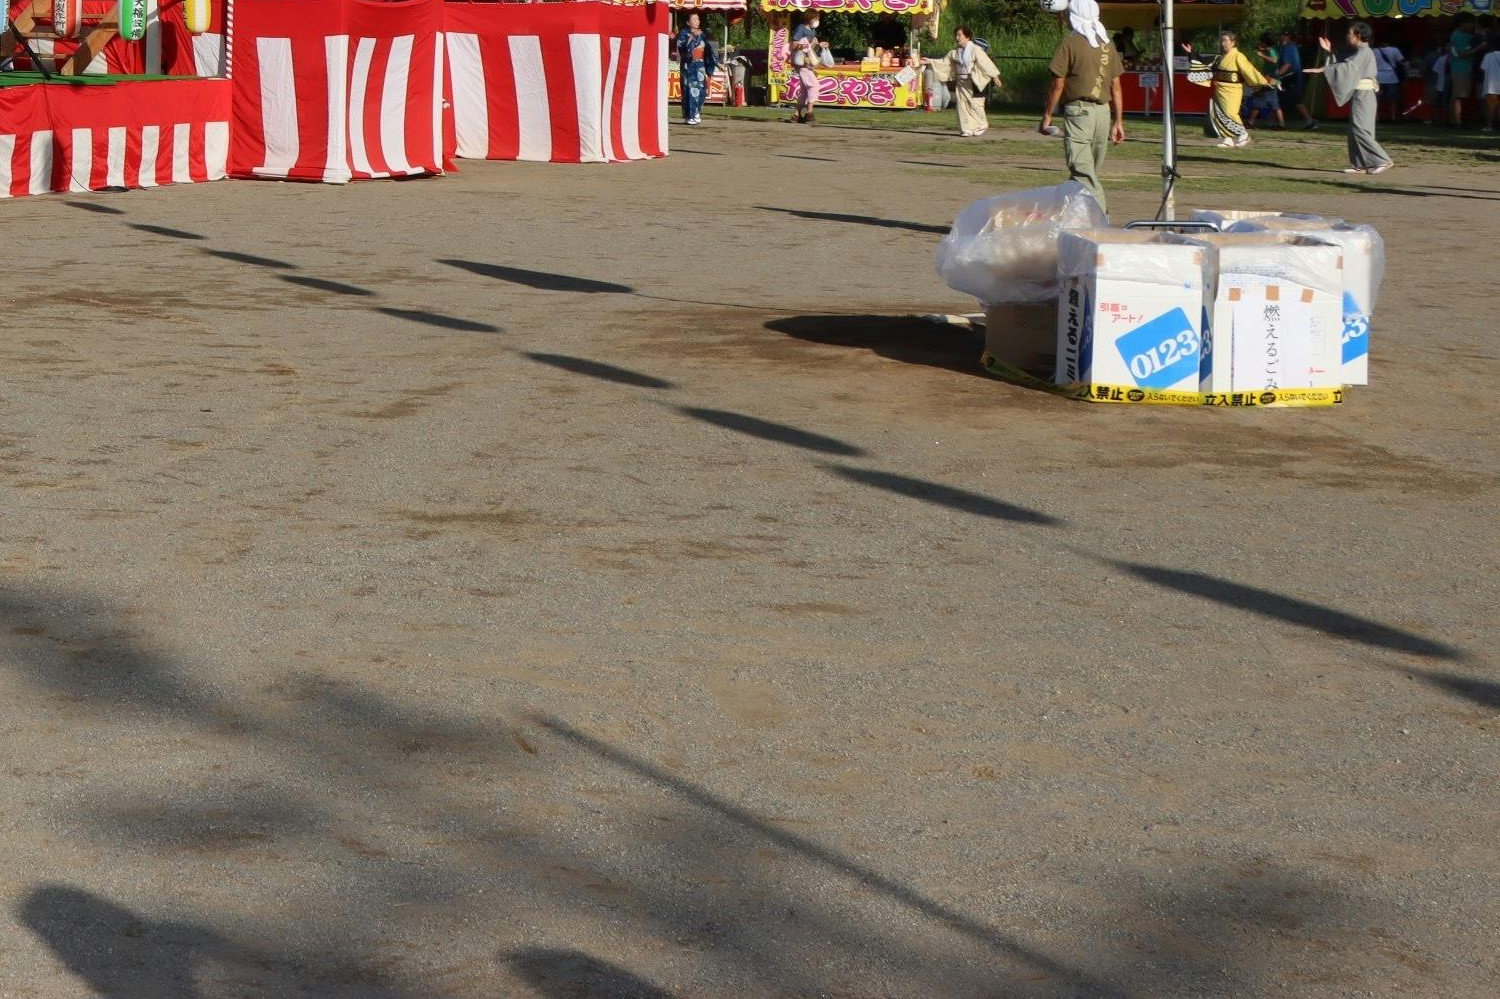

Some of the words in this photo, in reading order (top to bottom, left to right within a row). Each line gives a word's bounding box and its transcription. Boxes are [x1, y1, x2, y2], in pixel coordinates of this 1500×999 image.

[1130, 329, 1199, 379] 0123
[1263, 304, 1281, 390] 燃えるごみ
[1202, 392, 1256, 407] 立入禁止
